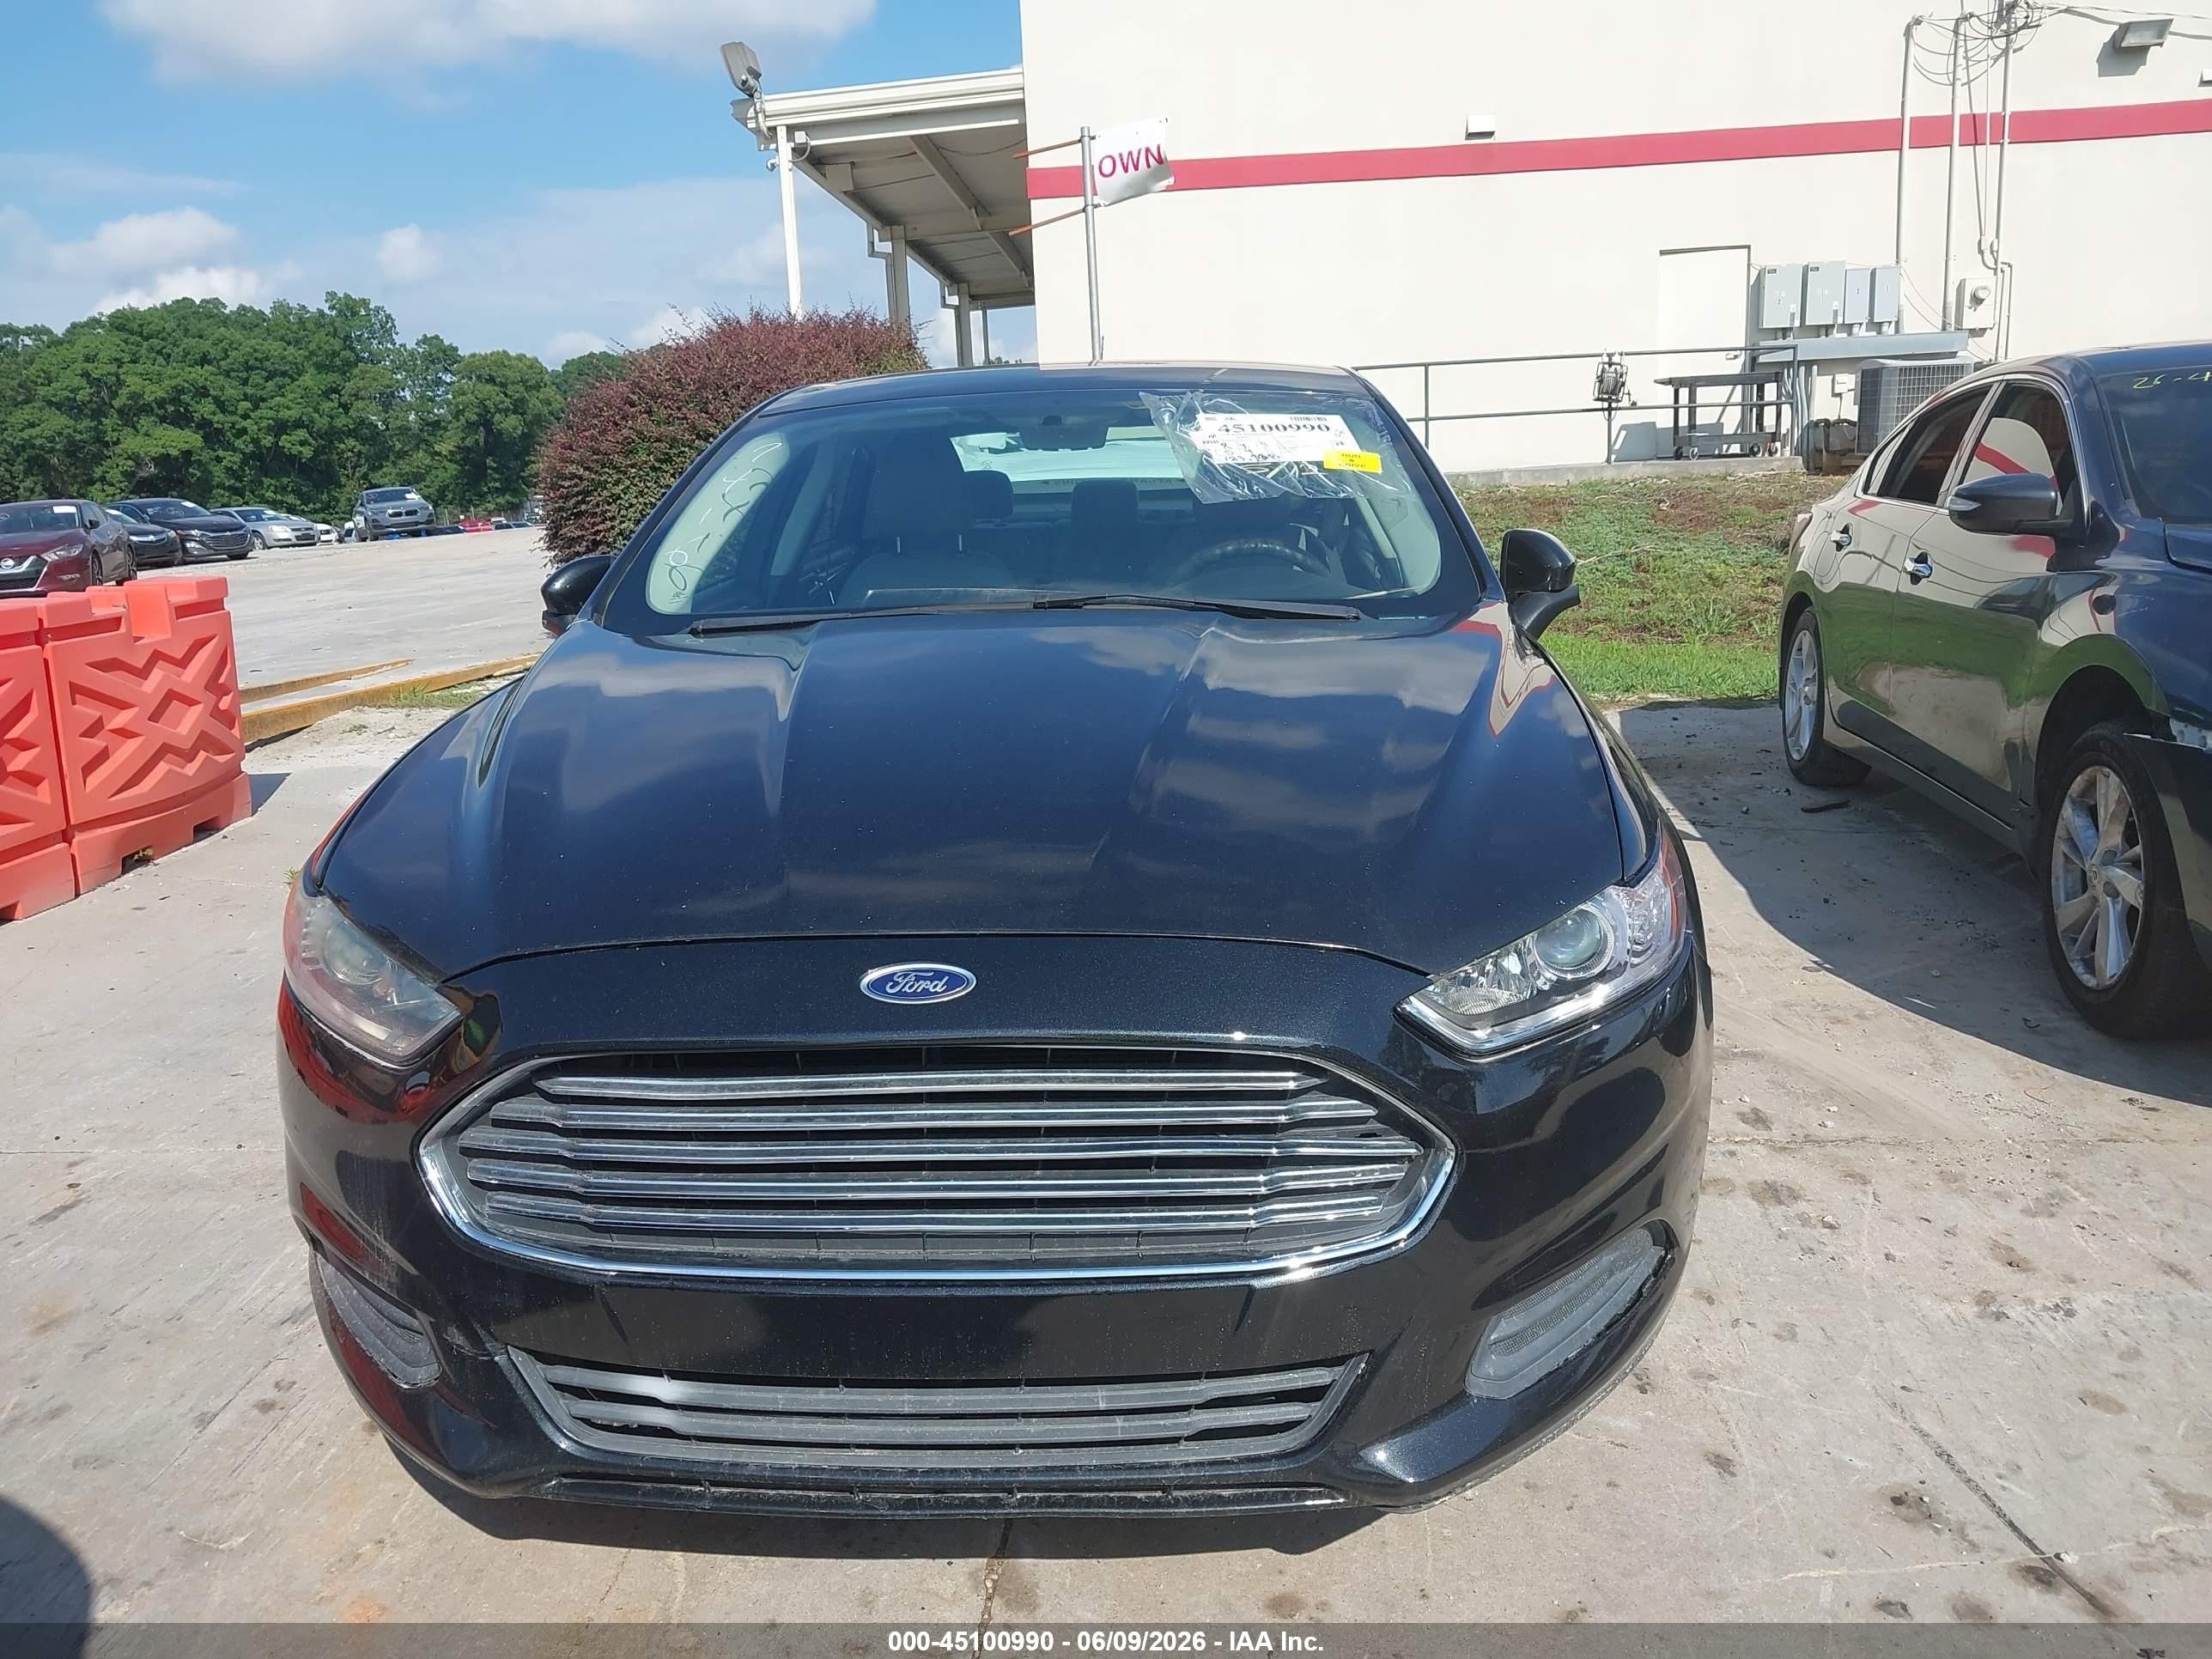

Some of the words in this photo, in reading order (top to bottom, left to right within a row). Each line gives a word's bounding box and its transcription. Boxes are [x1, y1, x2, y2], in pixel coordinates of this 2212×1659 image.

[1098, 143, 1164, 178] OWN
[1218, 423, 1330, 433] 45100990
[885, 971, 950, 994] Ford
